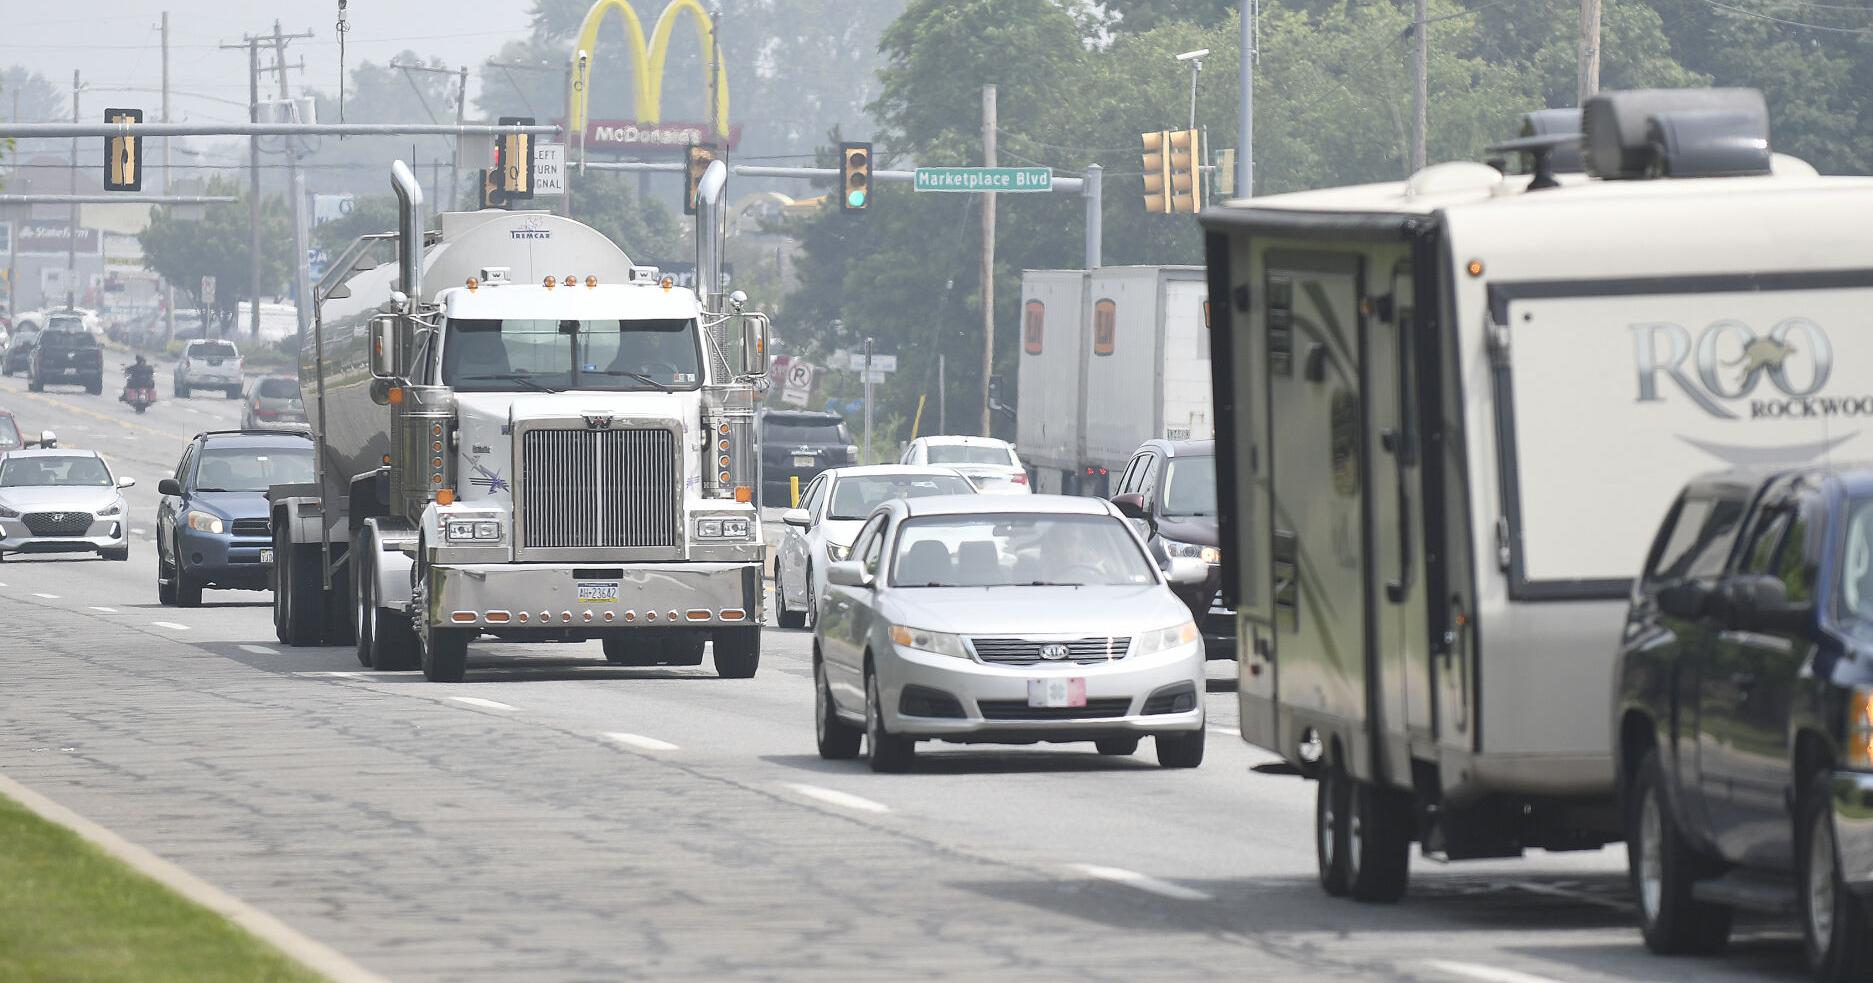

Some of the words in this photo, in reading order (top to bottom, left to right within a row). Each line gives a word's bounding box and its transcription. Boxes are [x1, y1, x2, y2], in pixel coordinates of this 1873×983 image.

[534, 164, 557, 174] URN
[536, 178, 562, 189] GNAL
[919, 171, 1010, 188] Marketplace
[1016, 171, 1048, 186] Blvd
[511, 230, 550, 239] TREMCAR
[1627, 316, 1834, 421] ROO
